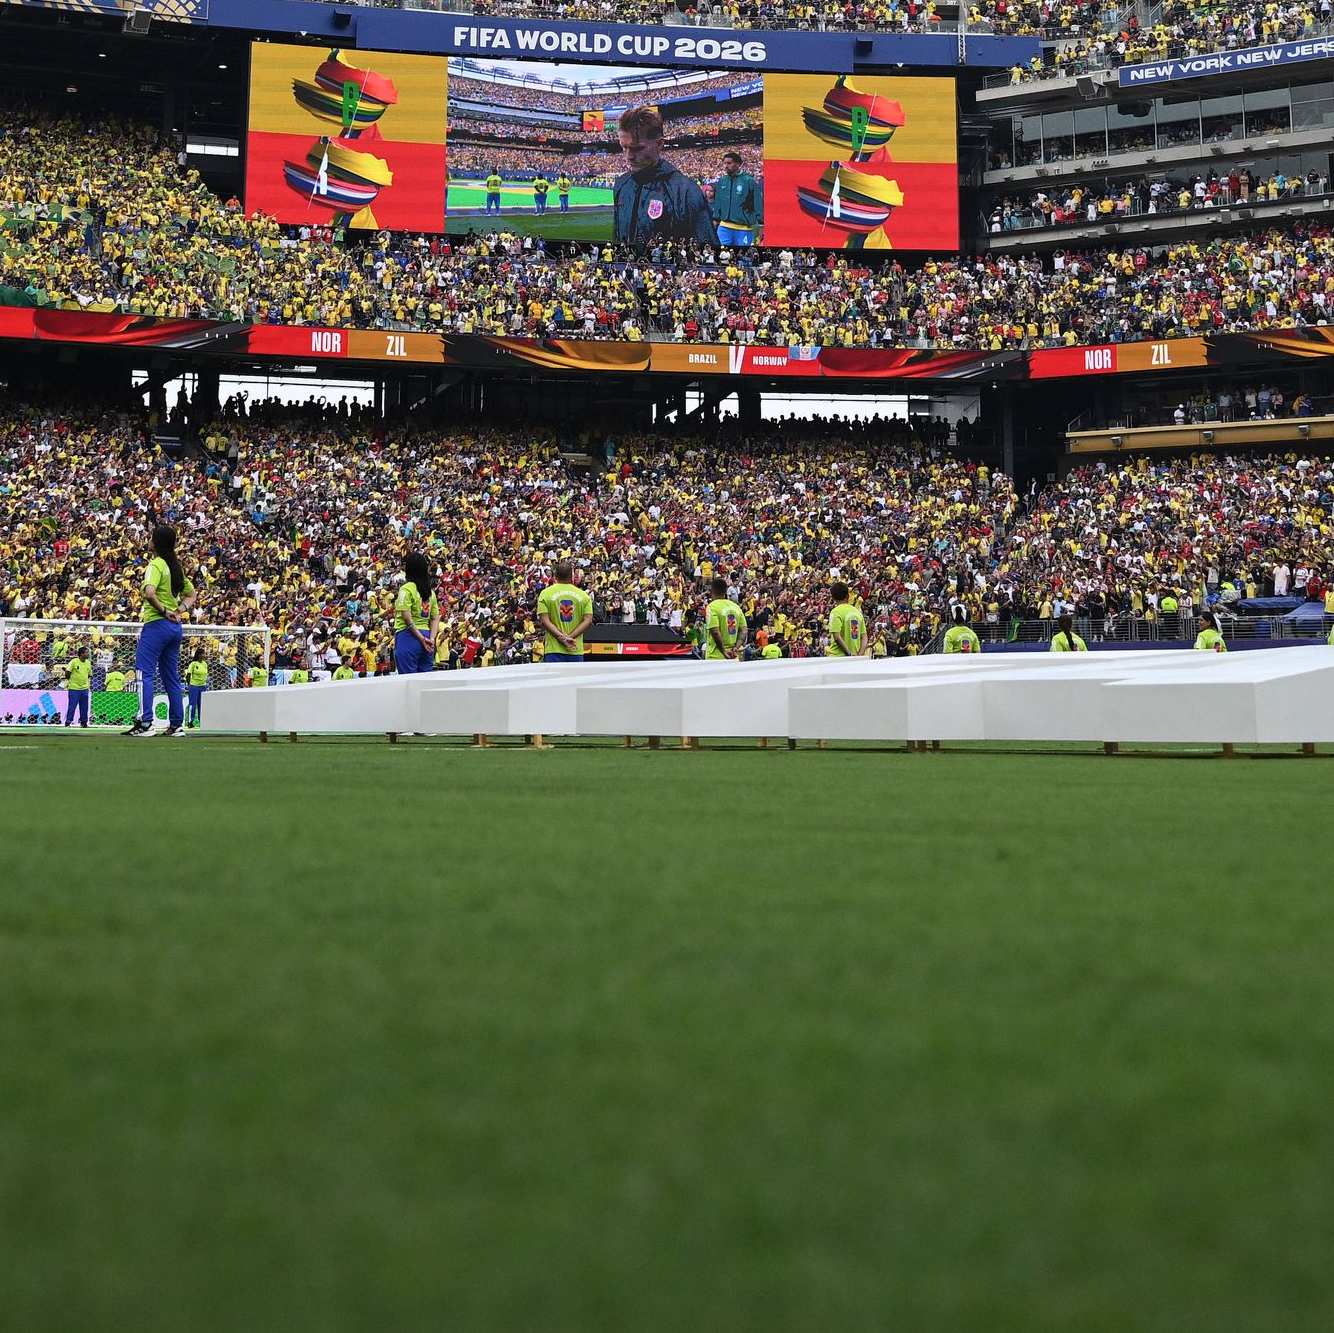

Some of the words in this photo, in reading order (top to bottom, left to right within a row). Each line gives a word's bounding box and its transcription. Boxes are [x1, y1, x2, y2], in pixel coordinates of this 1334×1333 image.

[453, 26, 511, 49] FIFA
[515, 29, 613, 53] WORLD
[617, 35, 670, 57] CUP
[674, 37, 768, 62] 2026
[1130, 67, 1173, 81] NEW
[1180, 56, 1232, 74] YORK
[1236, 51, 1275, 65] NEW
[311, 332, 342, 353] NOR
[386, 335, 407, 357] ZIL
[688, 353, 718, 364] BRAZIL
[752, 355, 788, 366] NORWAY
[1084, 349, 1112, 370] NOR
[1151, 344, 1172, 365] ZIL
